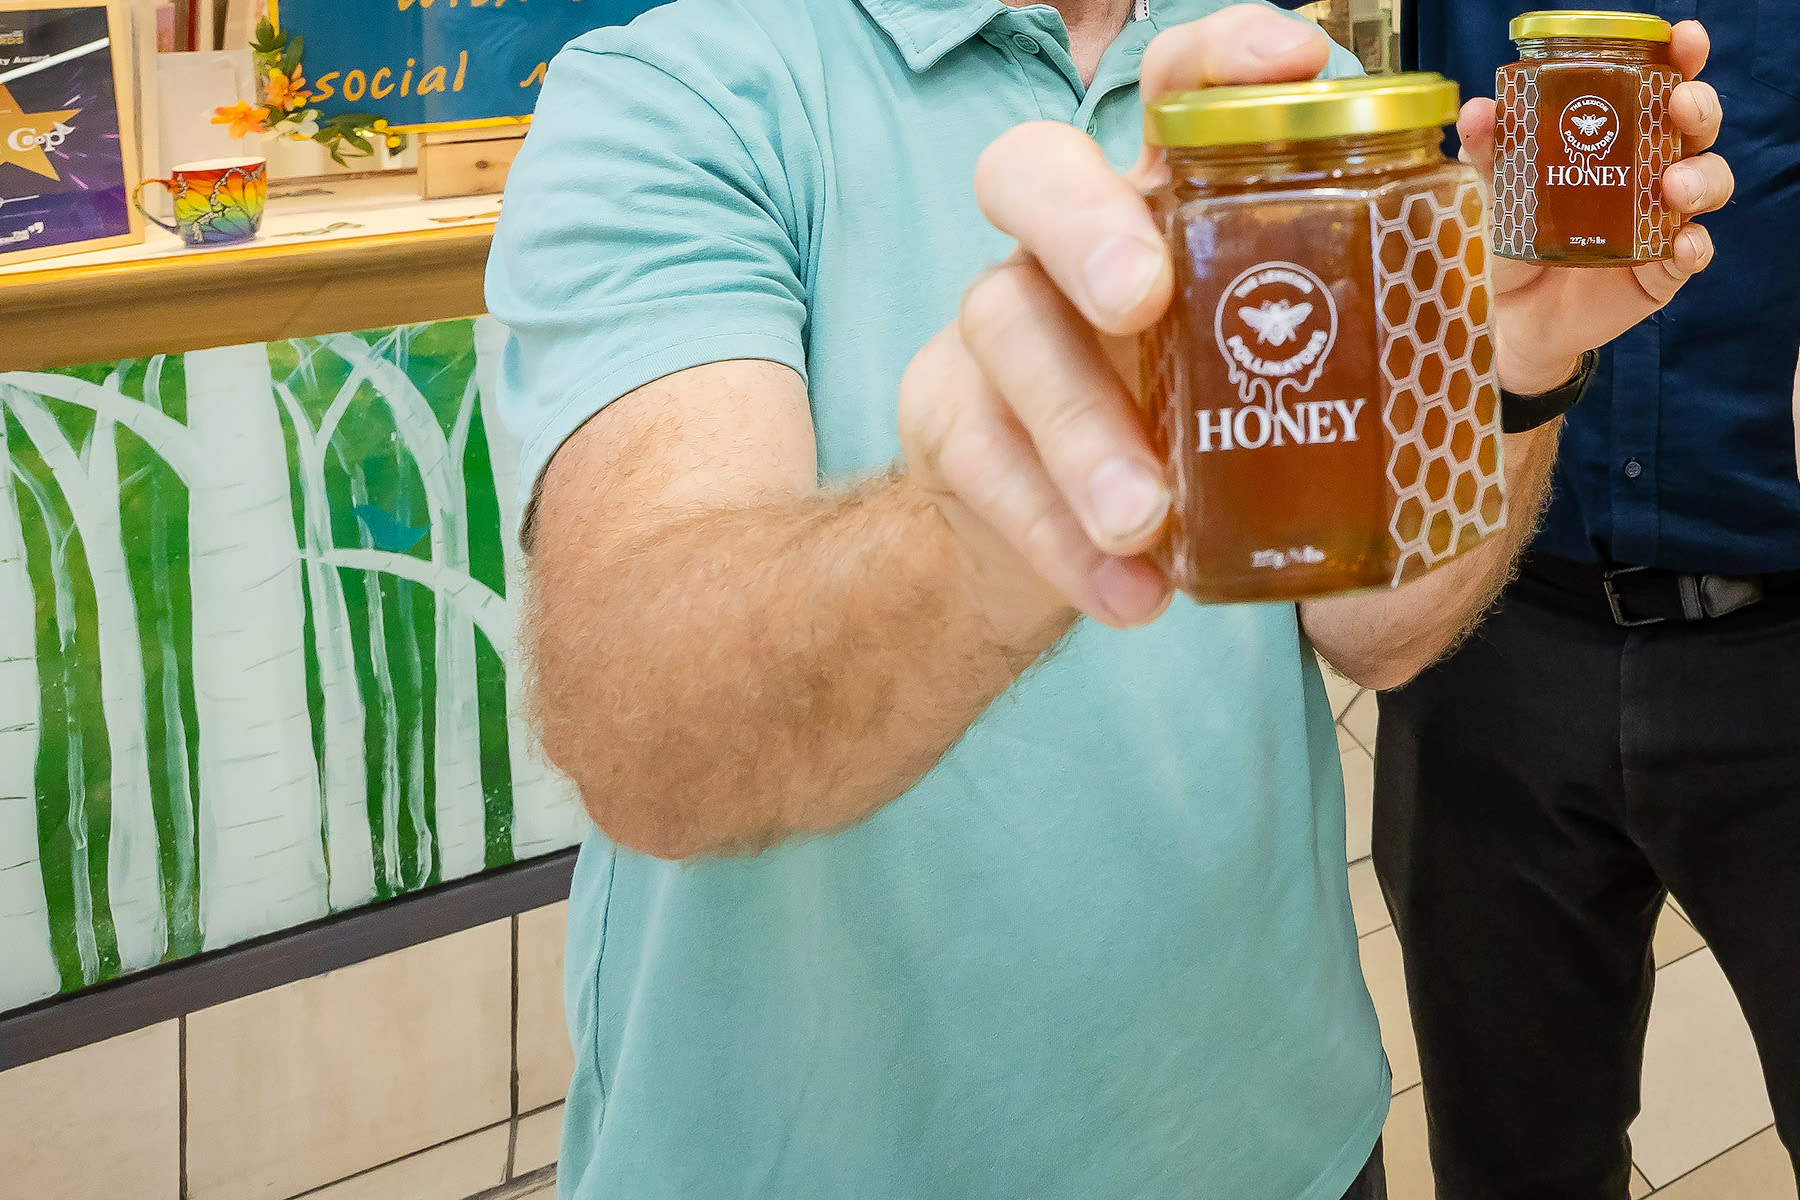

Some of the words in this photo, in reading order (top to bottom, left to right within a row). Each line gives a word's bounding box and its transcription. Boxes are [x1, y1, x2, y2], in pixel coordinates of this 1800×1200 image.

[309, 50, 468, 103] social
[1569, 101, 1582, 111] THE
[1582, 99, 1609, 112] LEXICON
[1564, 130, 1615, 151] POLLINATORS
[1545, 165, 1632, 187] HONEY
[1195, 398, 1367, 452] HONEY
